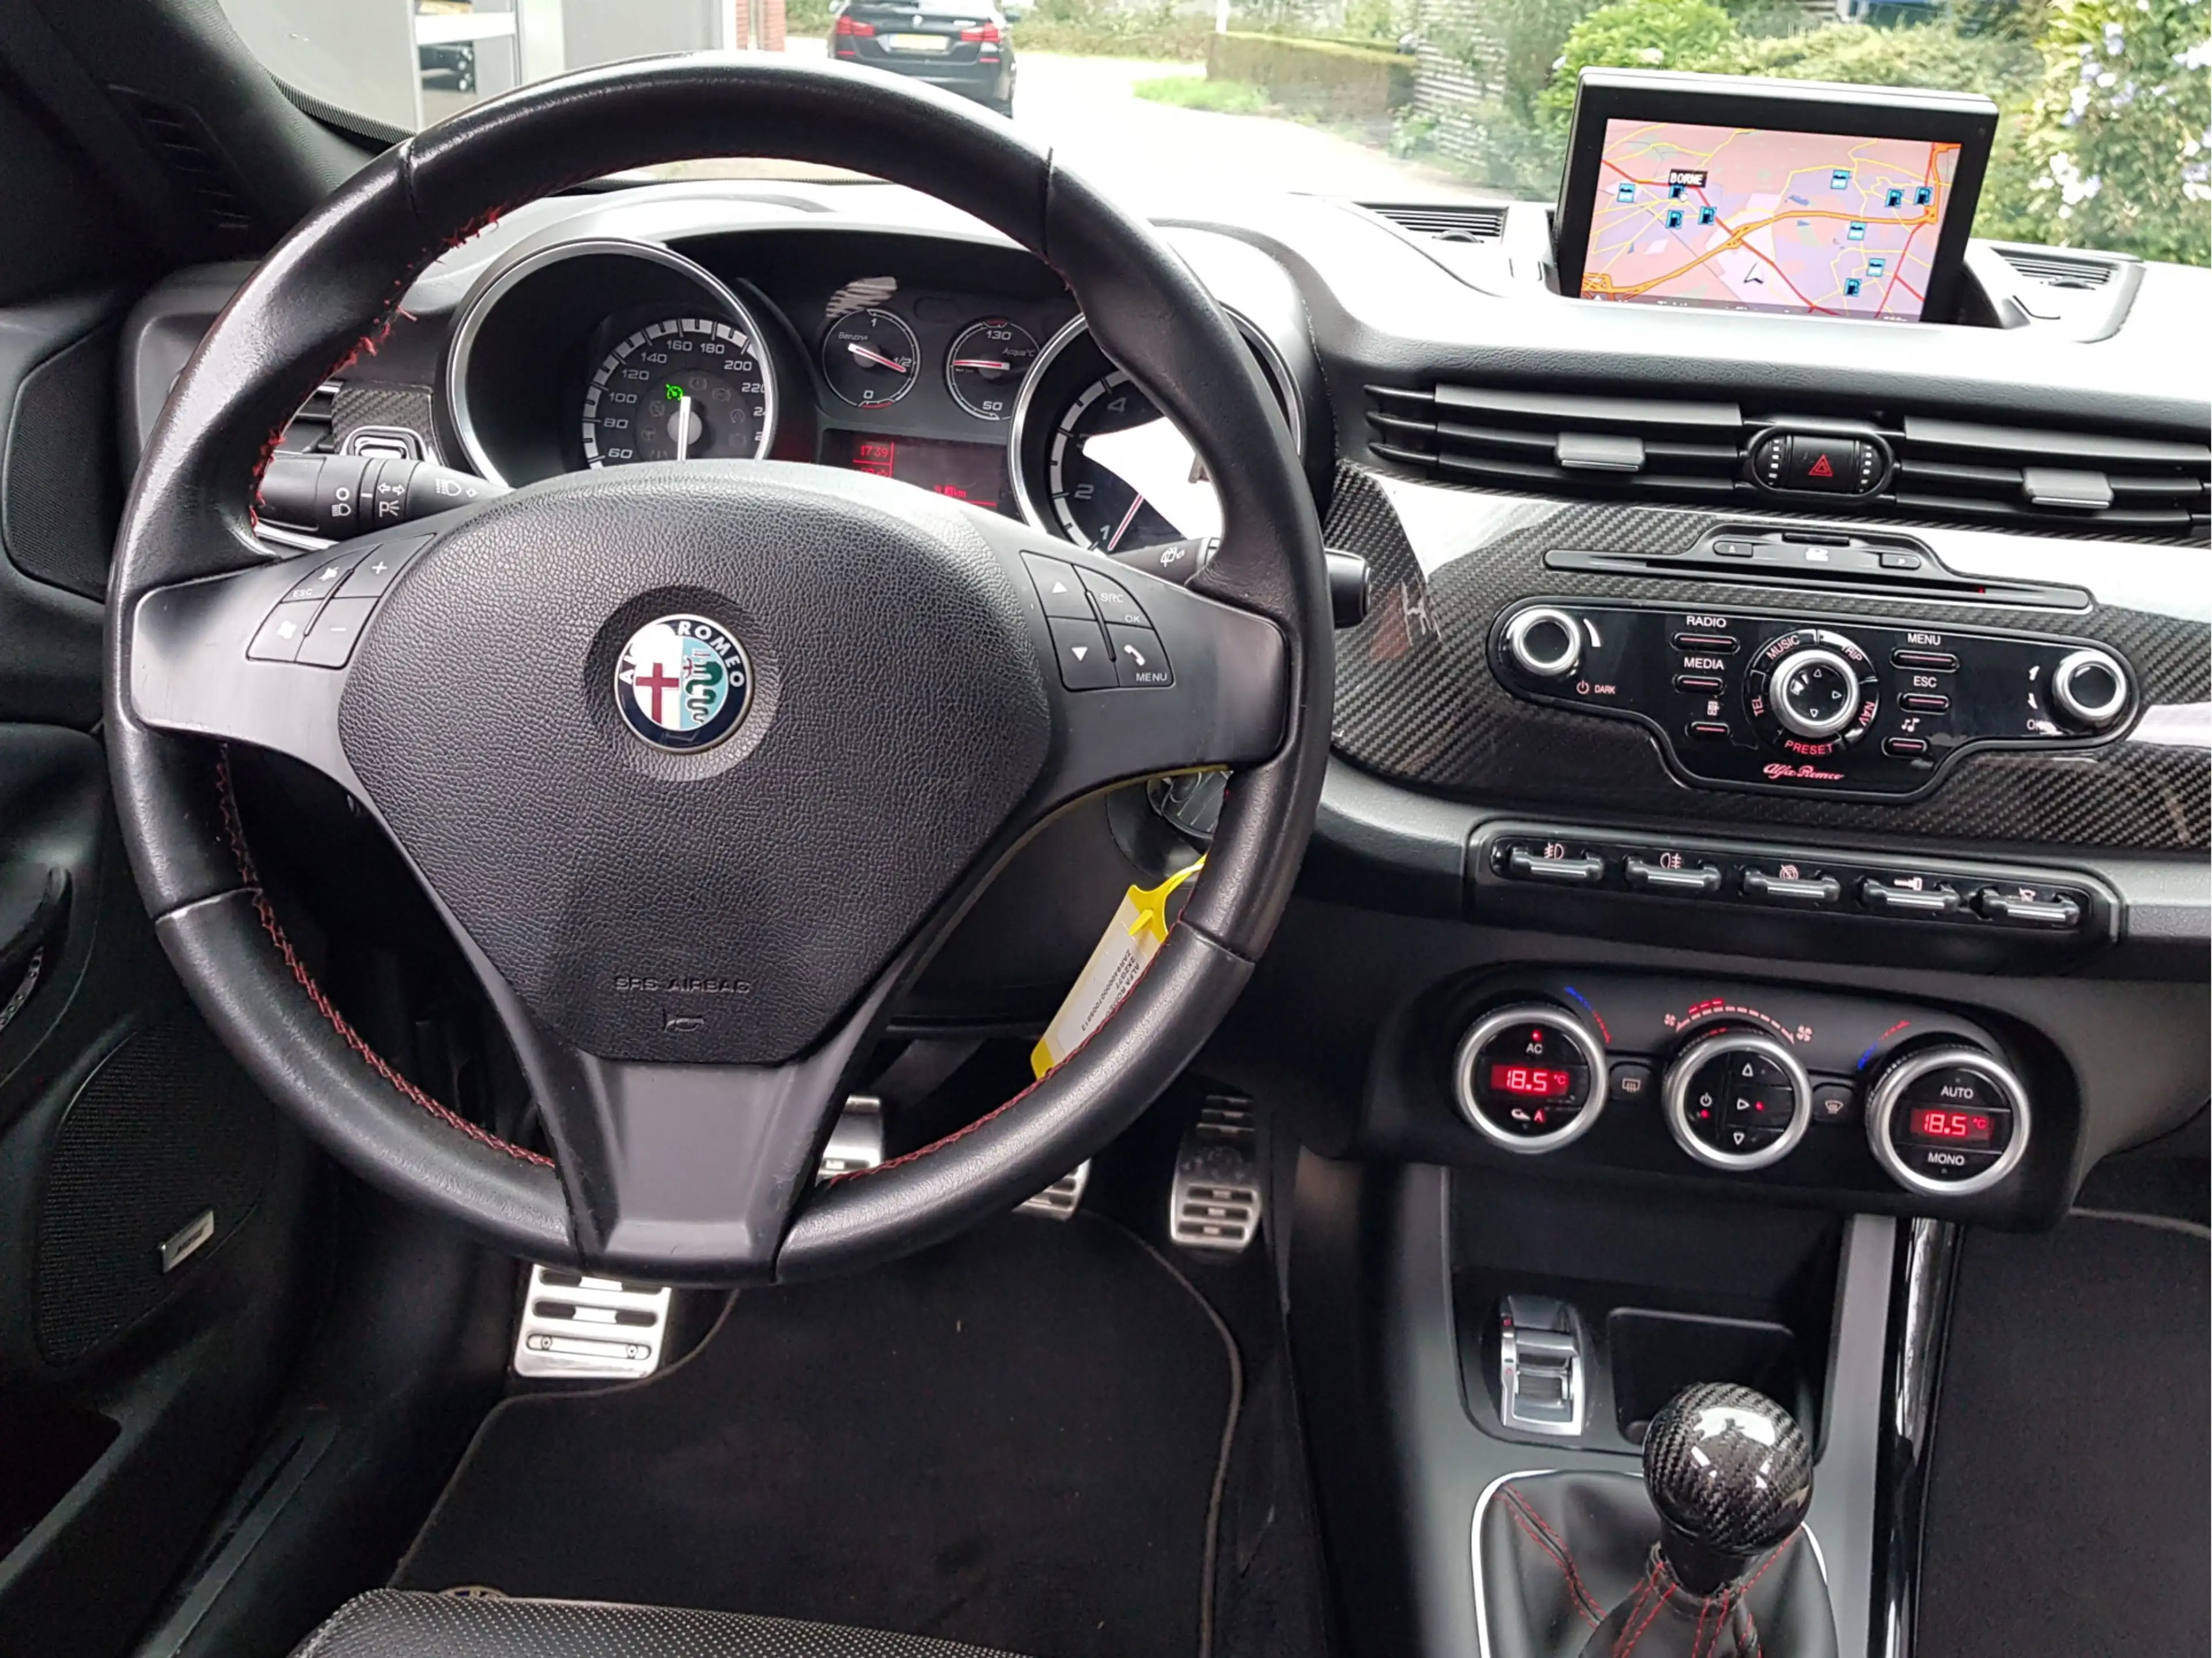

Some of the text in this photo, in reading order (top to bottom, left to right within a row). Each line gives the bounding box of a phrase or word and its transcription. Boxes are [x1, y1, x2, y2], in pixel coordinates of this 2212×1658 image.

[1670, 172, 1703, 185] BORNE
[986, 330, 1012, 340] 130
[666, 340, 693, 351] 160
[700, 343, 725, 355] 180
[641, 352, 668, 364] 140
[724, 359, 752, 372] 200
[622, 369, 650, 380] 120
[609, 392, 638, 403] 100
[982, 401, 1003, 411] 50
[1107, 397, 1127, 412] 4
[604, 418, 628, 429] 80
[608, 448, 633, 459] 60
[1073, 483, 1094, 499] 2
[1100, 525, 1111, 540] 1
[293, 588, 313, 597] ESC
[1100, 593, 1124, 603] SRC
[1124, 615, 1141, 623] OK
[1686, 615, 1727, 629] RADIO
[1907, 634, 1941, 645] MENU
[678, 620, 745, 687] ROMEO
[1766, 635, 1800, 660] MUSIC
[1684, 657, 1725, 670] MEDIA
[1136, 673, 1168, 682] MENU
[1913, 676, 1937, 687] ESC
[1594, 684, 1616, 694] DARK
[1751, 695, 1764, 717] TEL
[1858, 701, 1875, 726] NAV
[1784, 740, 1834, 755] PRESET
[1525, 1043, 1543, 1054] AC
[1506, 1070, 1548, 1092] 18.5
[1940, 1085, 1974, 1099] AUTO
[1923, 1113, 1967, 1135] 18.5
[1927, 1152, 1965, 1166] MONO
